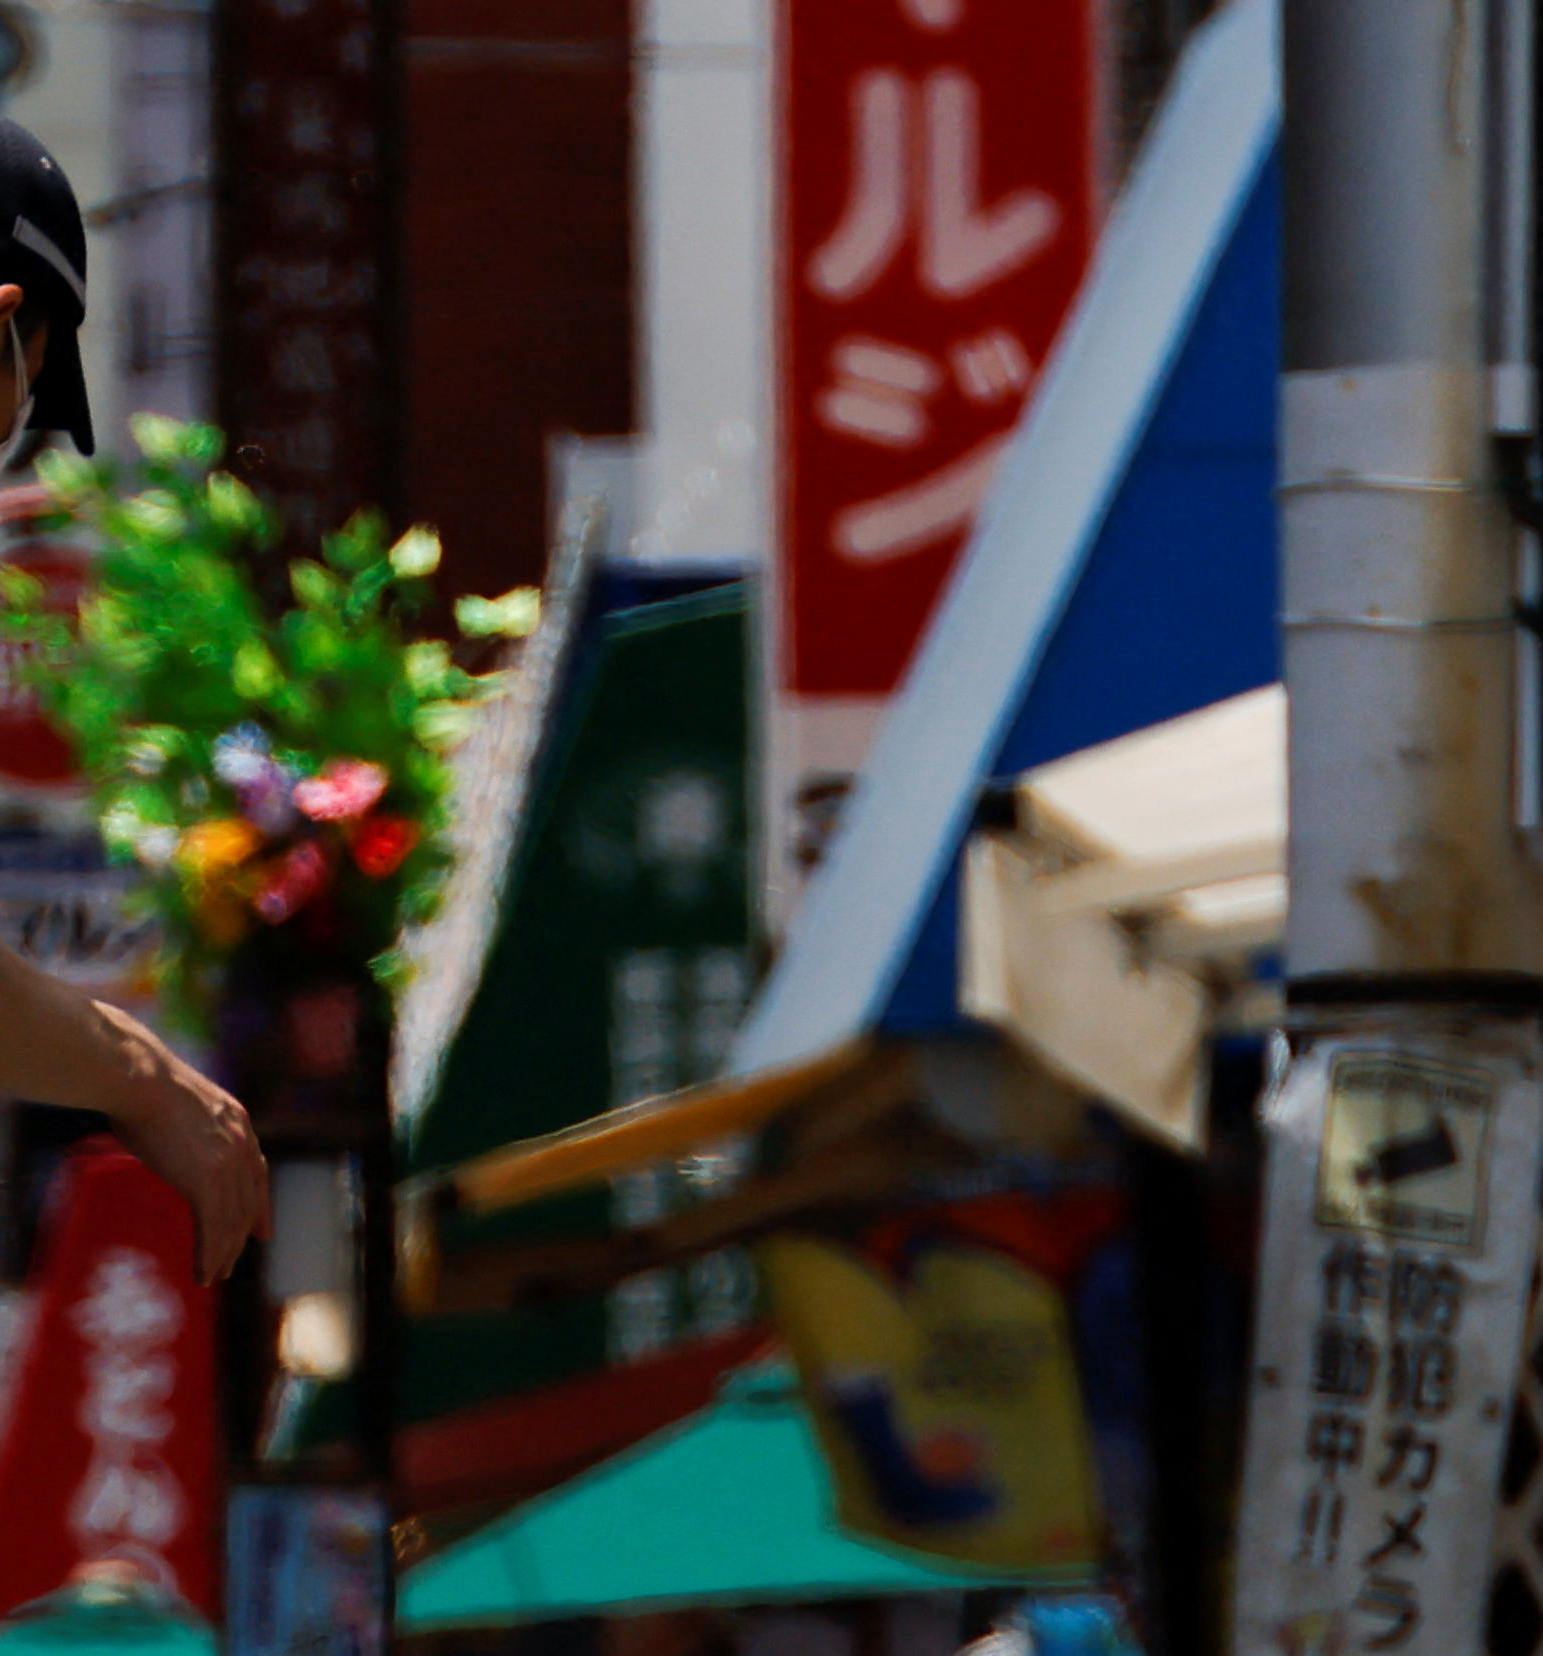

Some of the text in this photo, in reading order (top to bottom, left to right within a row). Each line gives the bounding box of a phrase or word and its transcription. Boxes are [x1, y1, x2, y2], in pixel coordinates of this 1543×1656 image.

[806, 0, 1063, 565] ルジ
[1351, 1252, 1459, 1650] 防犯カメラ
